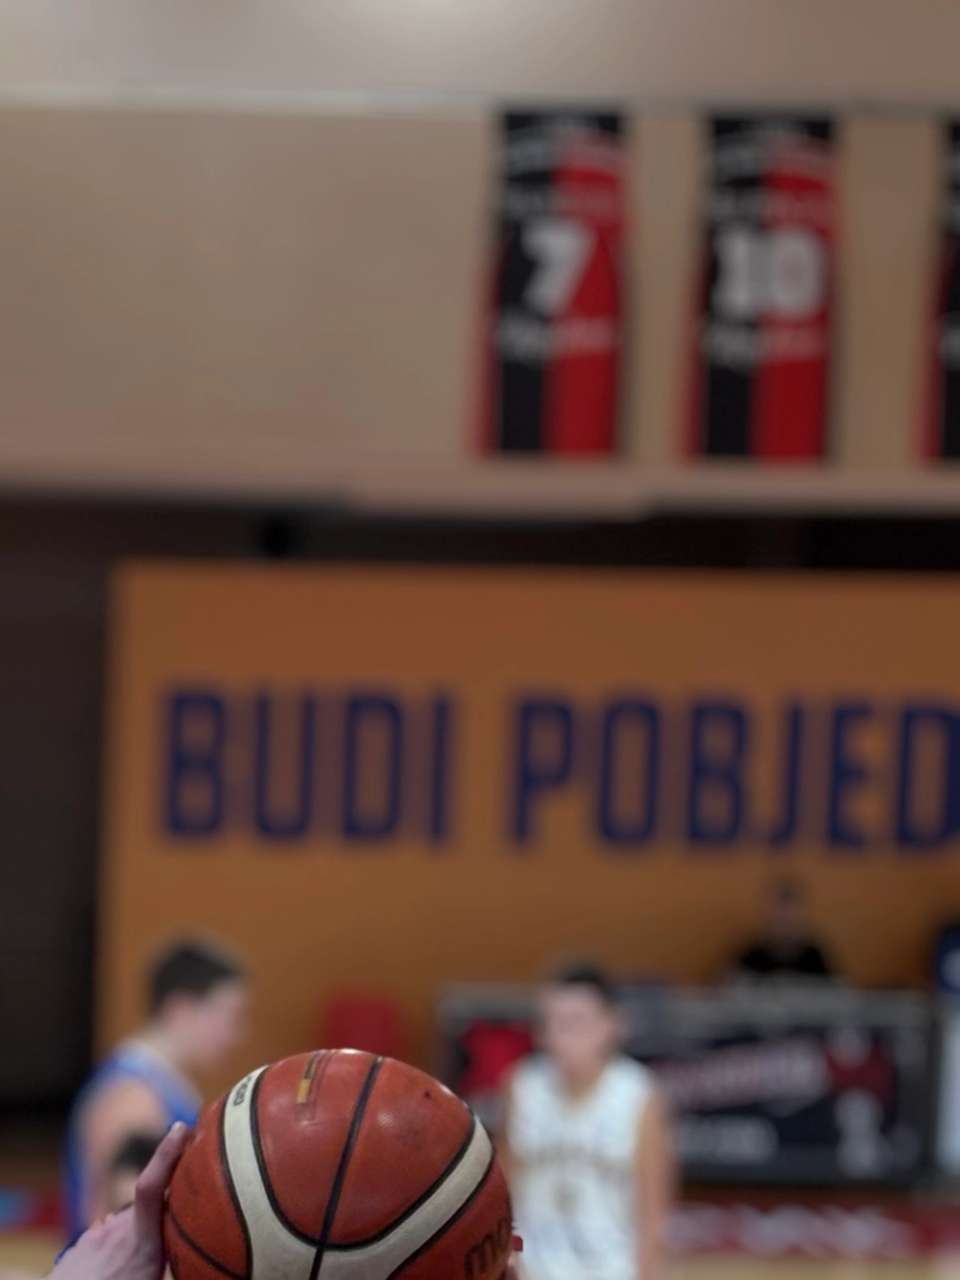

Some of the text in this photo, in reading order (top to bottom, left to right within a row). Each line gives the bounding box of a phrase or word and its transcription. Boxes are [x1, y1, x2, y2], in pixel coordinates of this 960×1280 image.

[521, 219, 597, 314] 7
[714, 222, 824, 322] 10
[160, 688, 960, 852] BUDI POBJED
